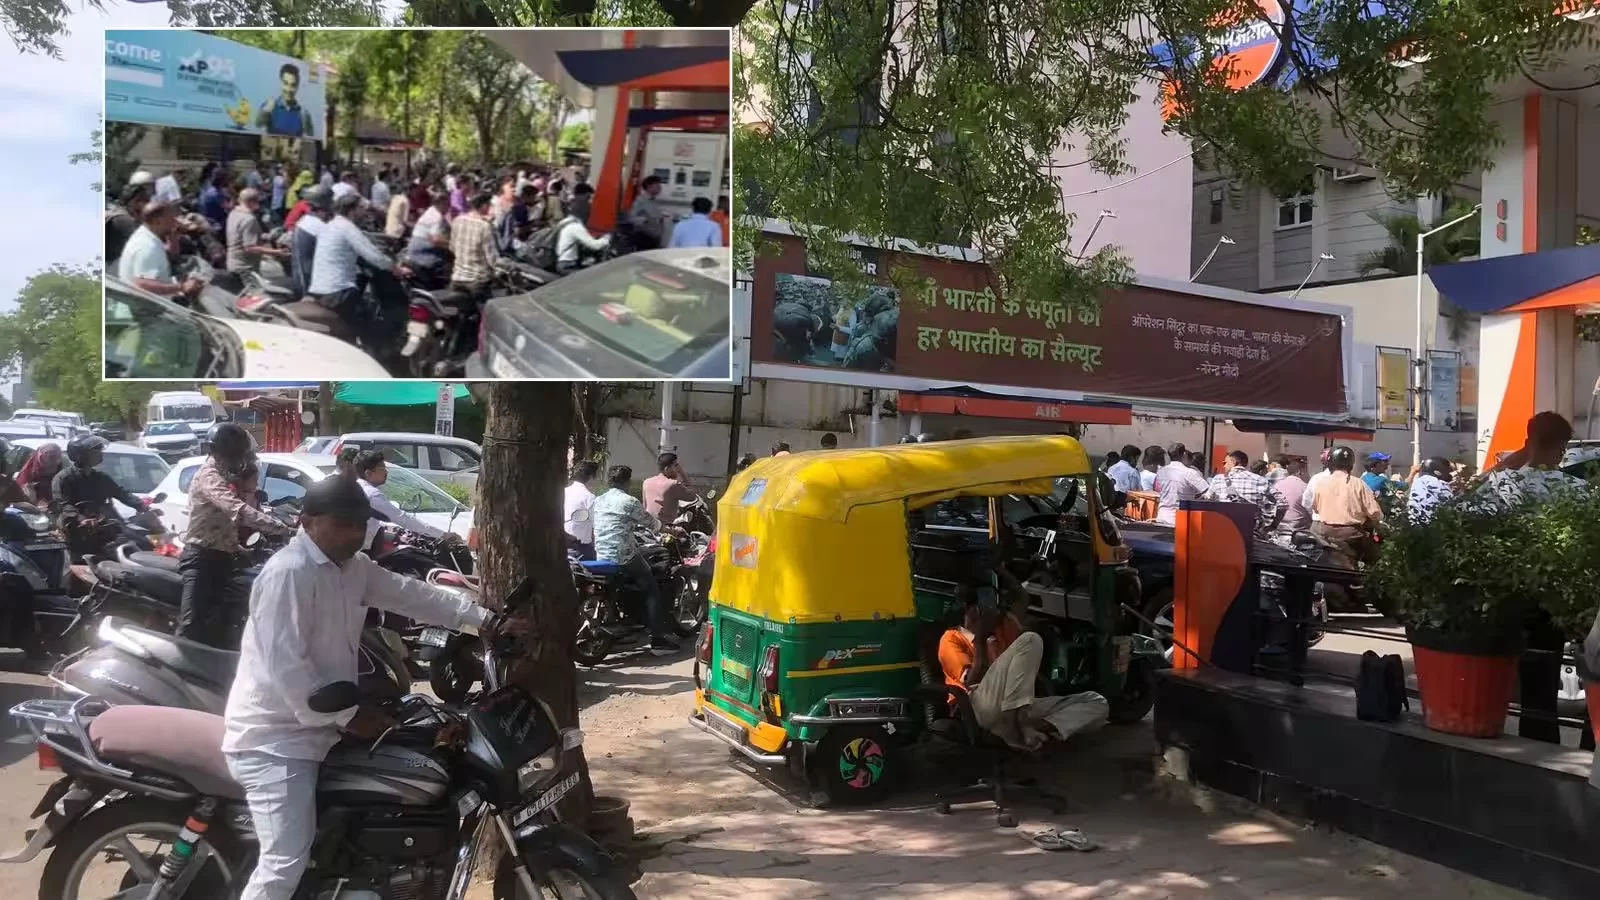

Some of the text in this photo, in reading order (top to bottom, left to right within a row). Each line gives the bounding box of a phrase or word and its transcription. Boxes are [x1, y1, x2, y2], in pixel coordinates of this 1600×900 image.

[943, 286, 996, 314] भारती
[917, 326, 1102, 372] हर भारतीय का सैल्यूट
[1035, 405, 1061, 418] AIR
